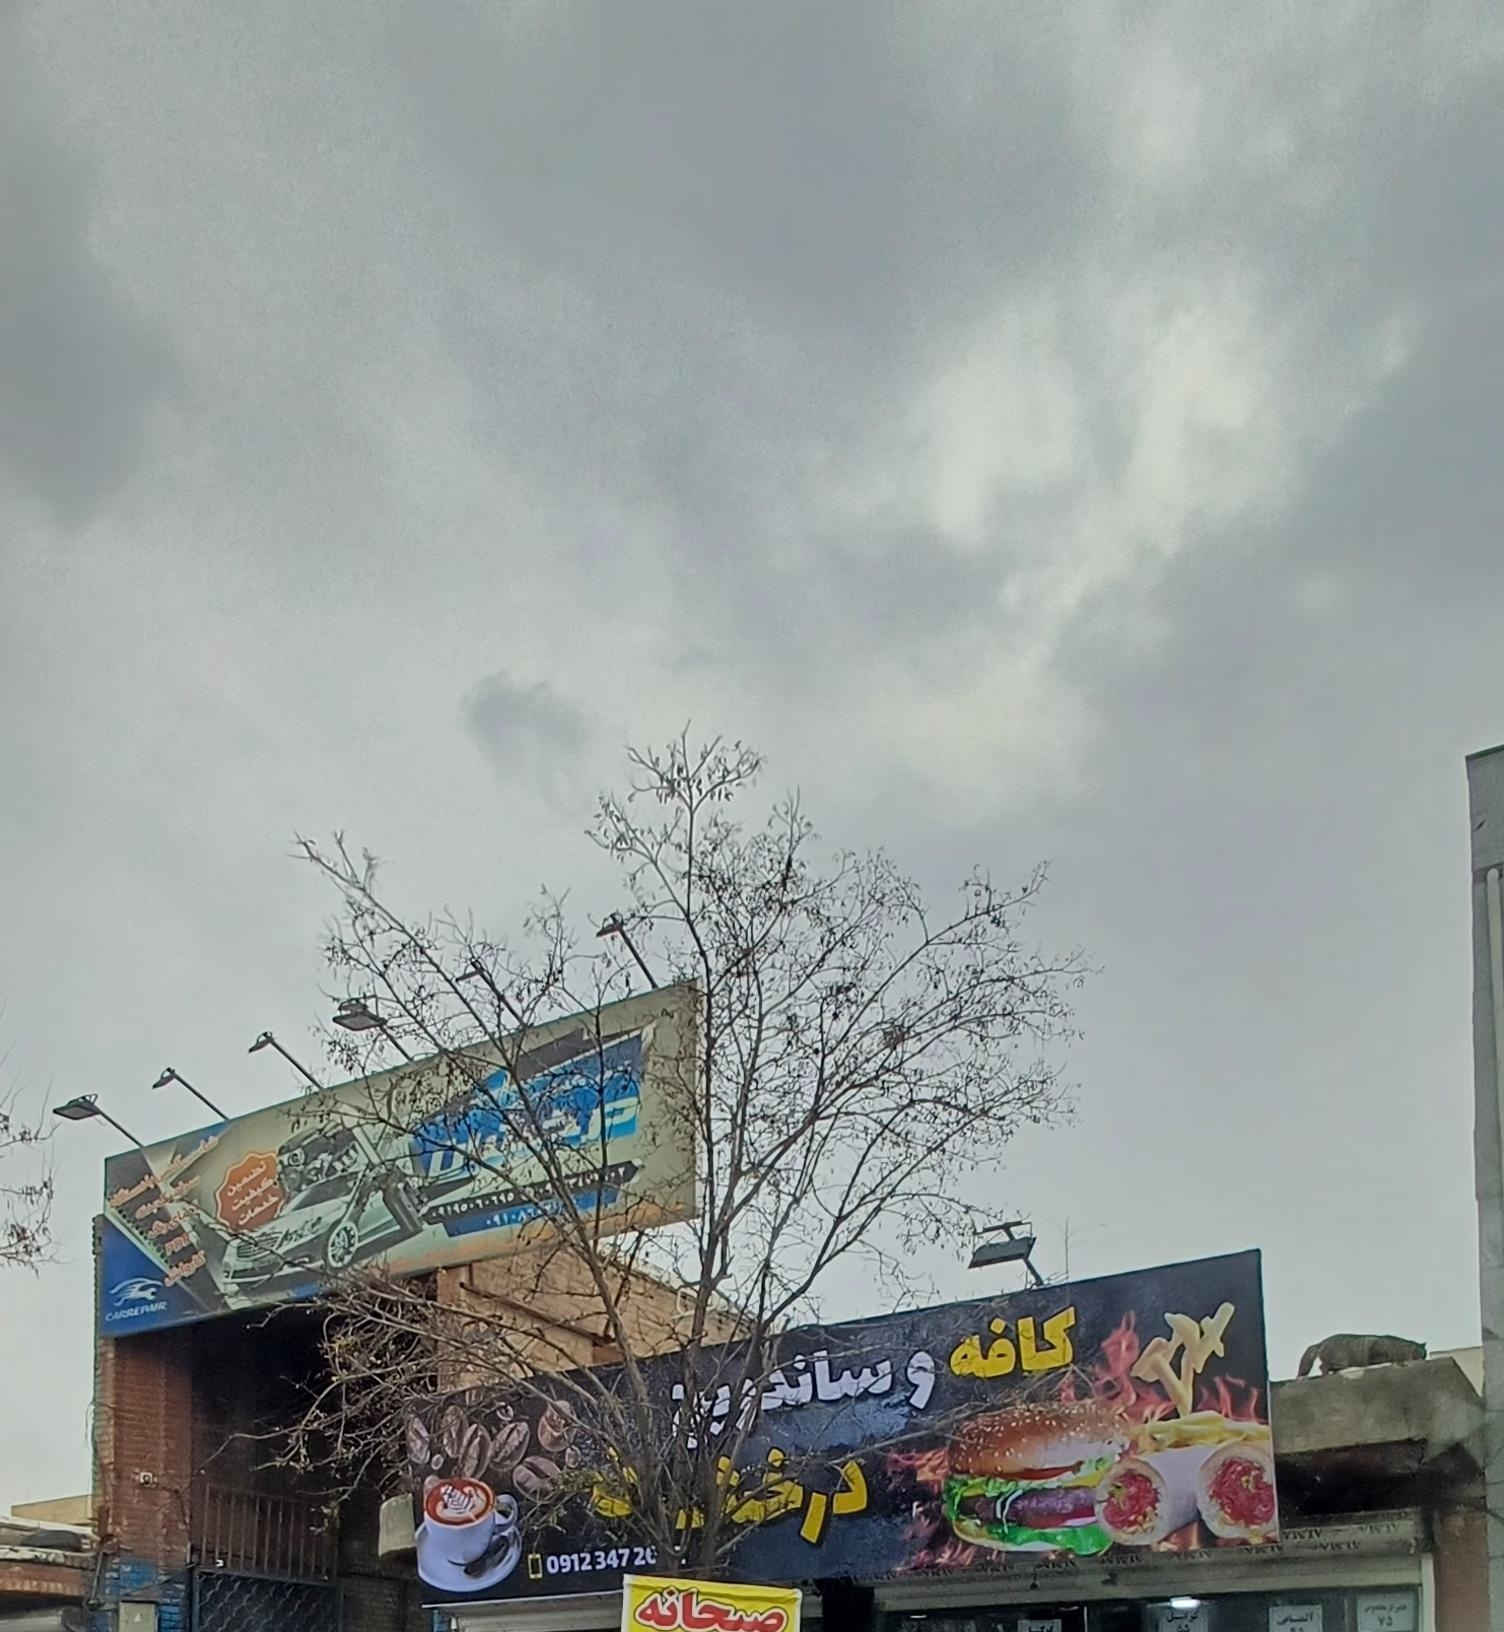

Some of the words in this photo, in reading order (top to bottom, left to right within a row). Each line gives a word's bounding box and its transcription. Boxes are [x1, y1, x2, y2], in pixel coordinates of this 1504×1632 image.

[949, 1306, 1076, 1379] کافه
[906, 1350, 937, 1409] و
[546, 1551, 591, 1574] 0912
[595, 1548, 631, 1570] 347
